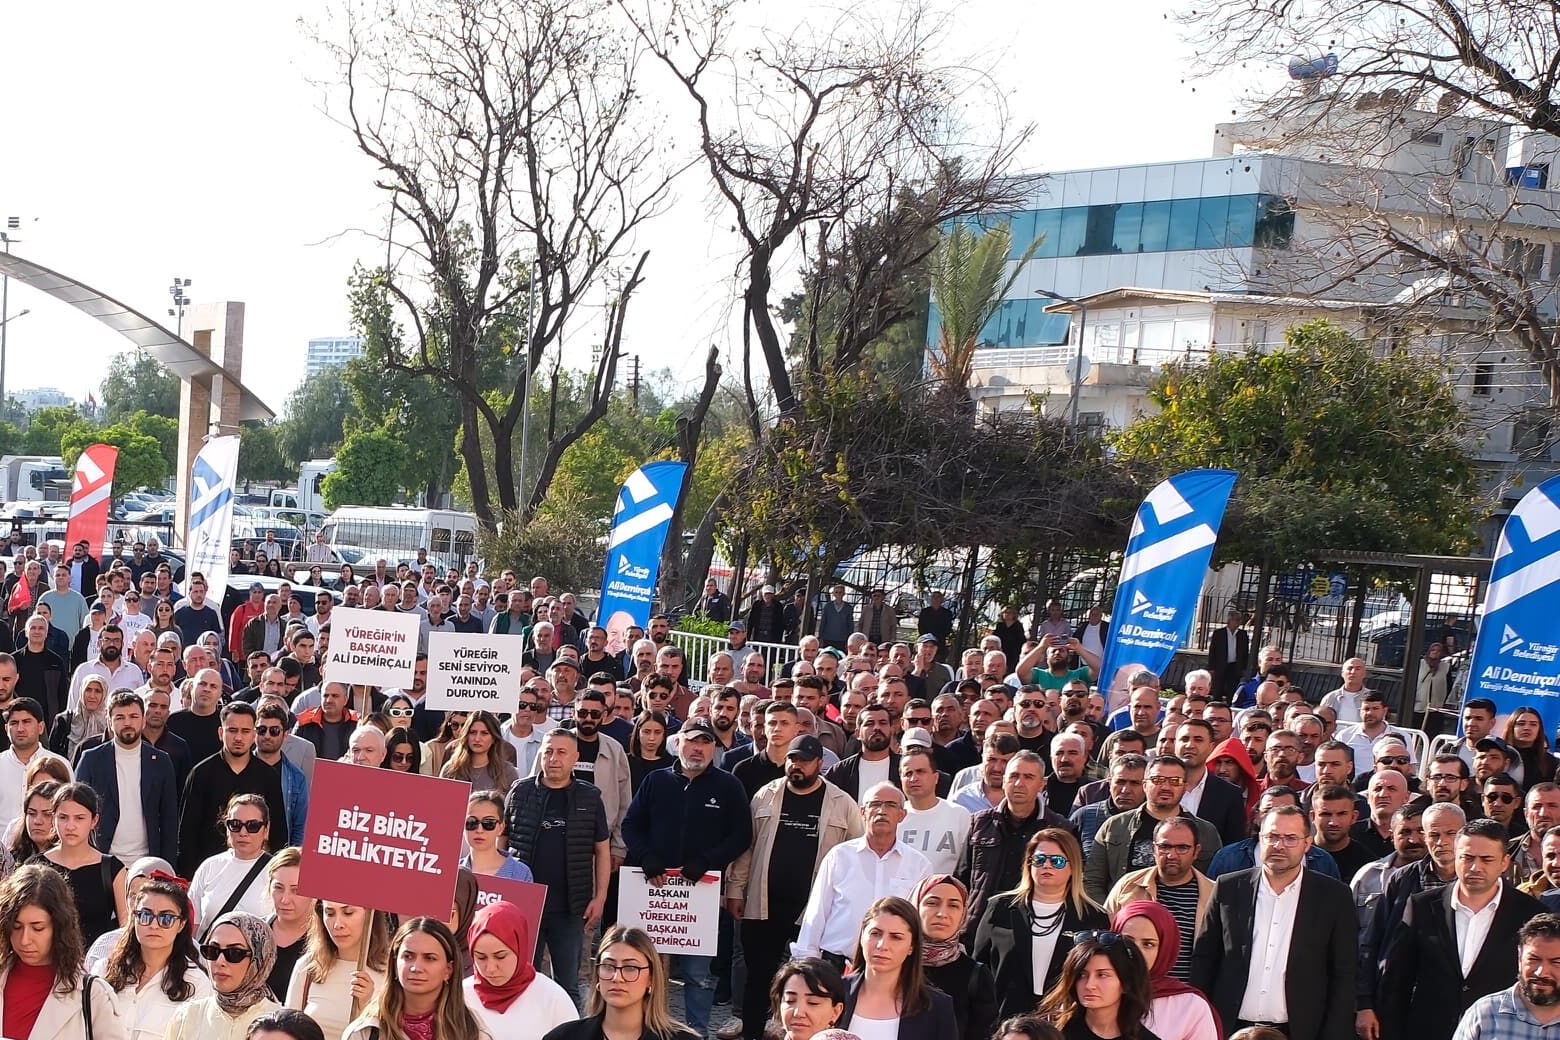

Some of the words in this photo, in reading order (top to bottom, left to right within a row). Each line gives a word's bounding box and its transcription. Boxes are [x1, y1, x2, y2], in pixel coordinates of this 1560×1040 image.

[344, 627, 406, 643] YÜREĞİR'İN
[349, 641, 398, 656] BAŞKANI
[453, 647, 498, 660] YÜREĞİR
[332, 653, 350, 664] ALİ
[352, 654, 412, 670] DEMİRÇALI
[439, 659, 462, 672] SENİ
[464, 661, 511, 674] SEVİYOR,
[1481, 666, 1501, 679] Ali
[450, 675, 498, 687] YANINDA
[446, 688, 500, 699] DURUYOR.
[337, 805, 372, 833] BİZ
[373, 811, 430, 846] BİRİZ,
[317, 831, 442, 875] BİRLİKTEYİZ.
[648, 888, 690, 900] BAŞKANI
[648, 899, 688, 910] SAĞLAM
[639, 910, 697, 923] YÜREKLERİN
[646, 924, 688, 935] BAŞKANI
